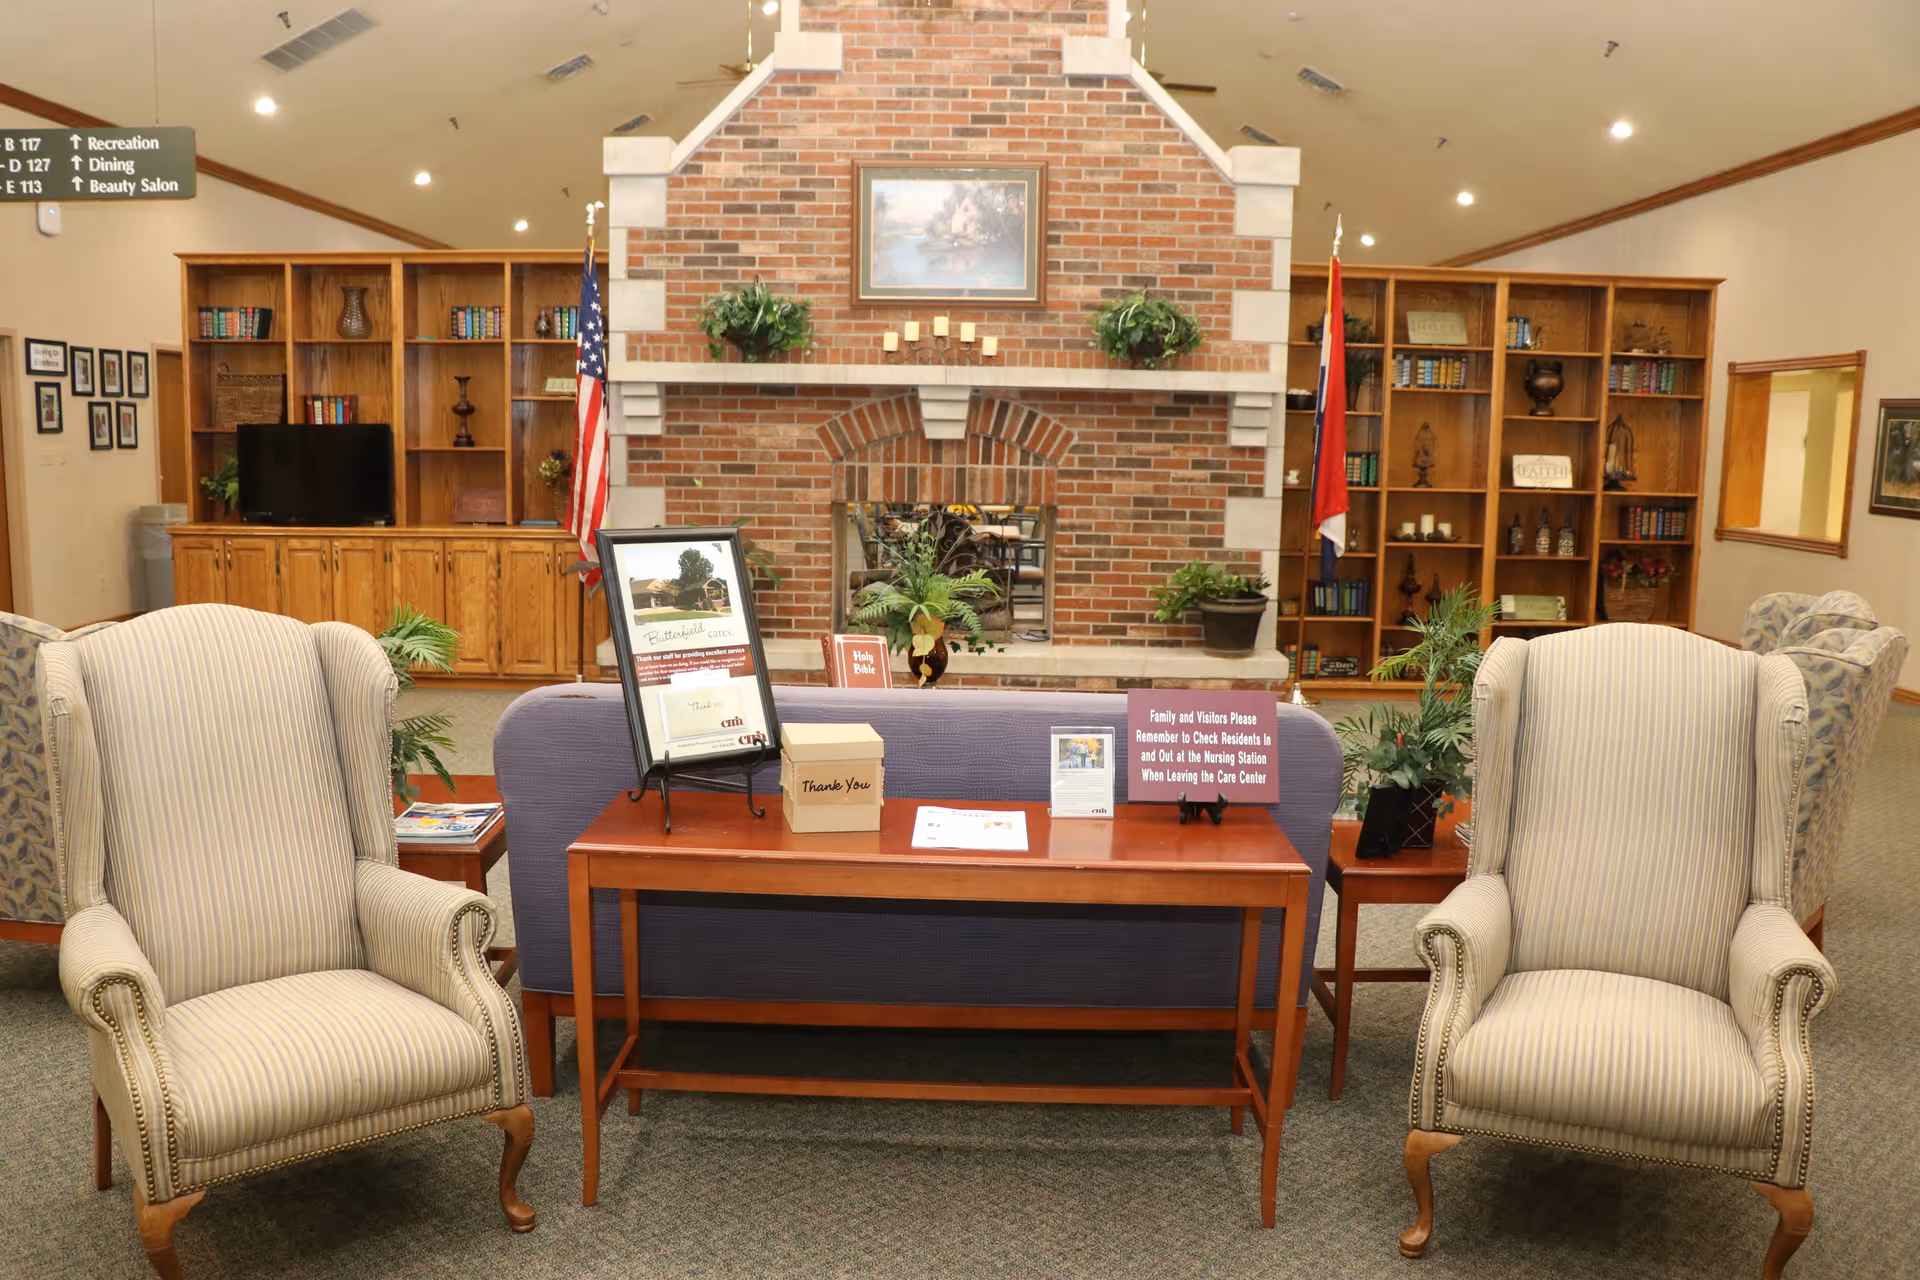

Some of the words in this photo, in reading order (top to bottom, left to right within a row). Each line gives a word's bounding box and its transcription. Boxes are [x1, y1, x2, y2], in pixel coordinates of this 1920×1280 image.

[4, 137, 15, 152] B
[19, 137, 42, 152] 117
[87, 136, 160, 151] Recreation
[9, 158, 22, 173] D
[26, 158, 51, 173] 127
[89, 157, 135, 175] Dining
[6, 179, 16, 194] E
[19, 179, 43, 194] 113
[90, 180, 136, 196] Beauty
[141, 177, 179, 192] Salon
[1521, 466, 1564, 477] FAITH
[643, 622, 705, 646] Butterfield
[707, 630, 735, 639] cares.
[682, 650, 705, 658] providing
[853, 650, 874, 664] Holy
[853, 663, 876, 675] Bible
[1150, 710, 1176, 725] Family
[1179, 711, 1194, 723] and
[1196, 711, 1228, 724] Visitors
[1230, 712, 1257, 725] Please
[1136, 730, 1178, 743] Remember
[1182, 731, 1190, 743] to
[1193, 731, 1218, 744] Check
[1222, 732, 1260, 745] Residents
[1264, 733, 1272, 746] In
[1141, 749, 1156, 762] and
[1158, 749, 1173, 762] Out
[1176, 750, 1184, 762] at
[1188, 750, 1201, 762] the
[1204, 750, 1234, 766] Nursing
[1238, 751, 1267, 764] Station
[1142, 768, 1164, 781] When
[1166, 769, 1198, 785] Leaving
[1201, 770, 1214, 783] the
[1218, 770, 1236, 783] Care
[1239, 770, 1266, 784] Center
[802, 779, 843, 793] Thank
[845, 776, 871, 793] You
